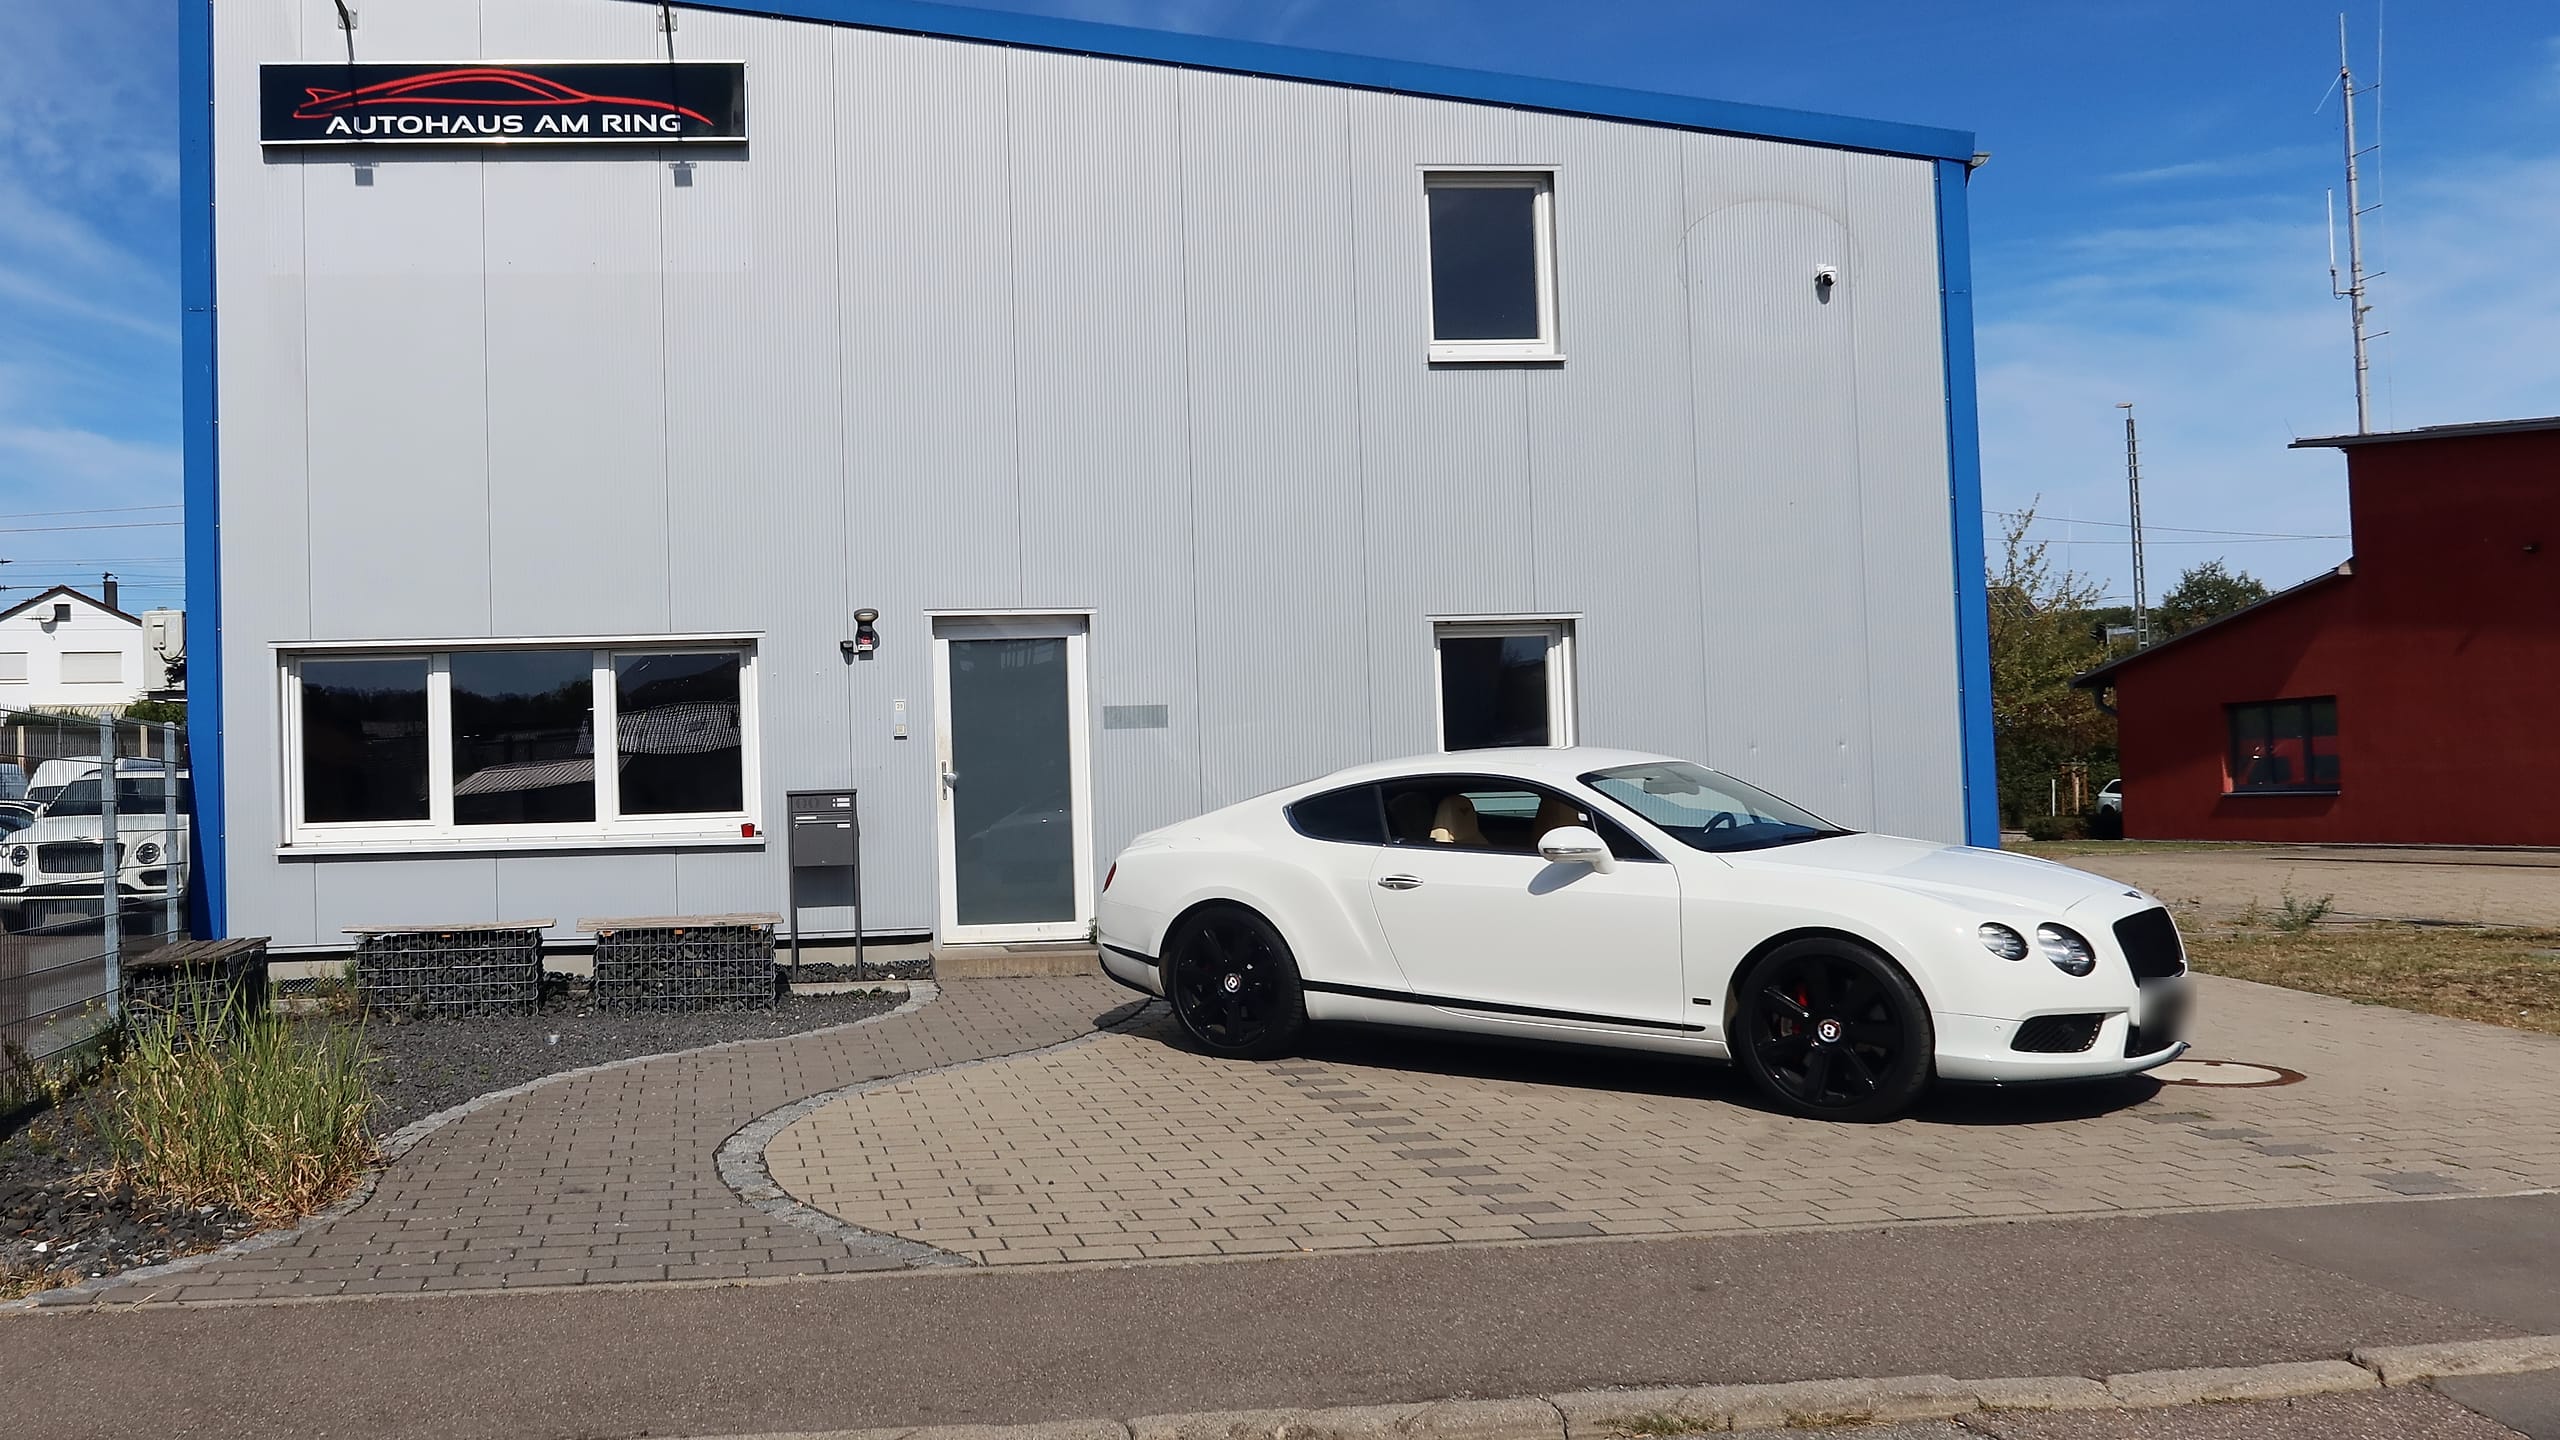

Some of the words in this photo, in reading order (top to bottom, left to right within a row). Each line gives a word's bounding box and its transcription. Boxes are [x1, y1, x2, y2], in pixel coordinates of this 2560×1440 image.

[325, 115, 524, 135] AUTOHAUS
[534, 114, 589, 133] AM
[602, 114, 681, 132] RING
